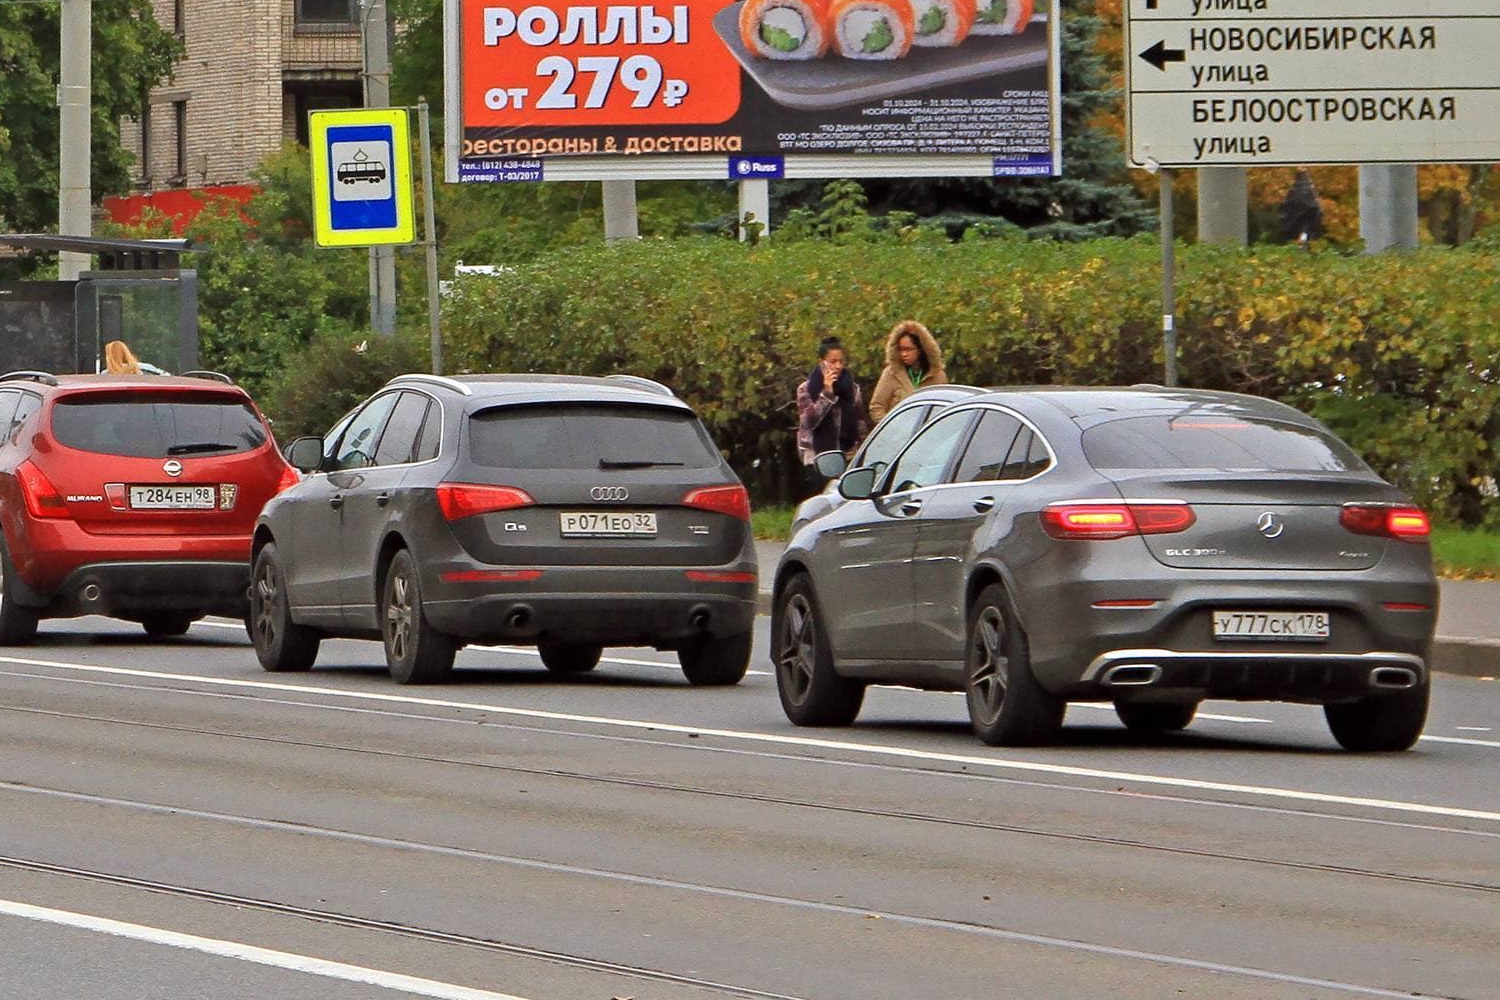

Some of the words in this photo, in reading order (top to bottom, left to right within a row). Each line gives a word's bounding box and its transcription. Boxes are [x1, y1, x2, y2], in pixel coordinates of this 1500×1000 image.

[483, 6, 689, 46] РОЛЛЫ
[1190, 25, 1437, 52] НОВОСИБИРСКАЯ
[1191, 63, 1269, 88] улица
[485, 87, 529, 110] от
[1192, 96, 1456, 123] БЕЛООСТРОВСКАЯ
[603, 136, 618, 152] &
[625, 135, 742, 155] доставка
[1193, 136, 1271, 160] улица
[752, 162, 777, 172] Russ
[137, 489, 193, 503] Т284ЕН
[195, 489, 210, 500] 98
[567, 514, 631, 531] Р071ЕО
[635, 514, 651, 527] 32
[1220, 614, 1295, 634] У777СК
[1297, 613, 1325, 629] 178
